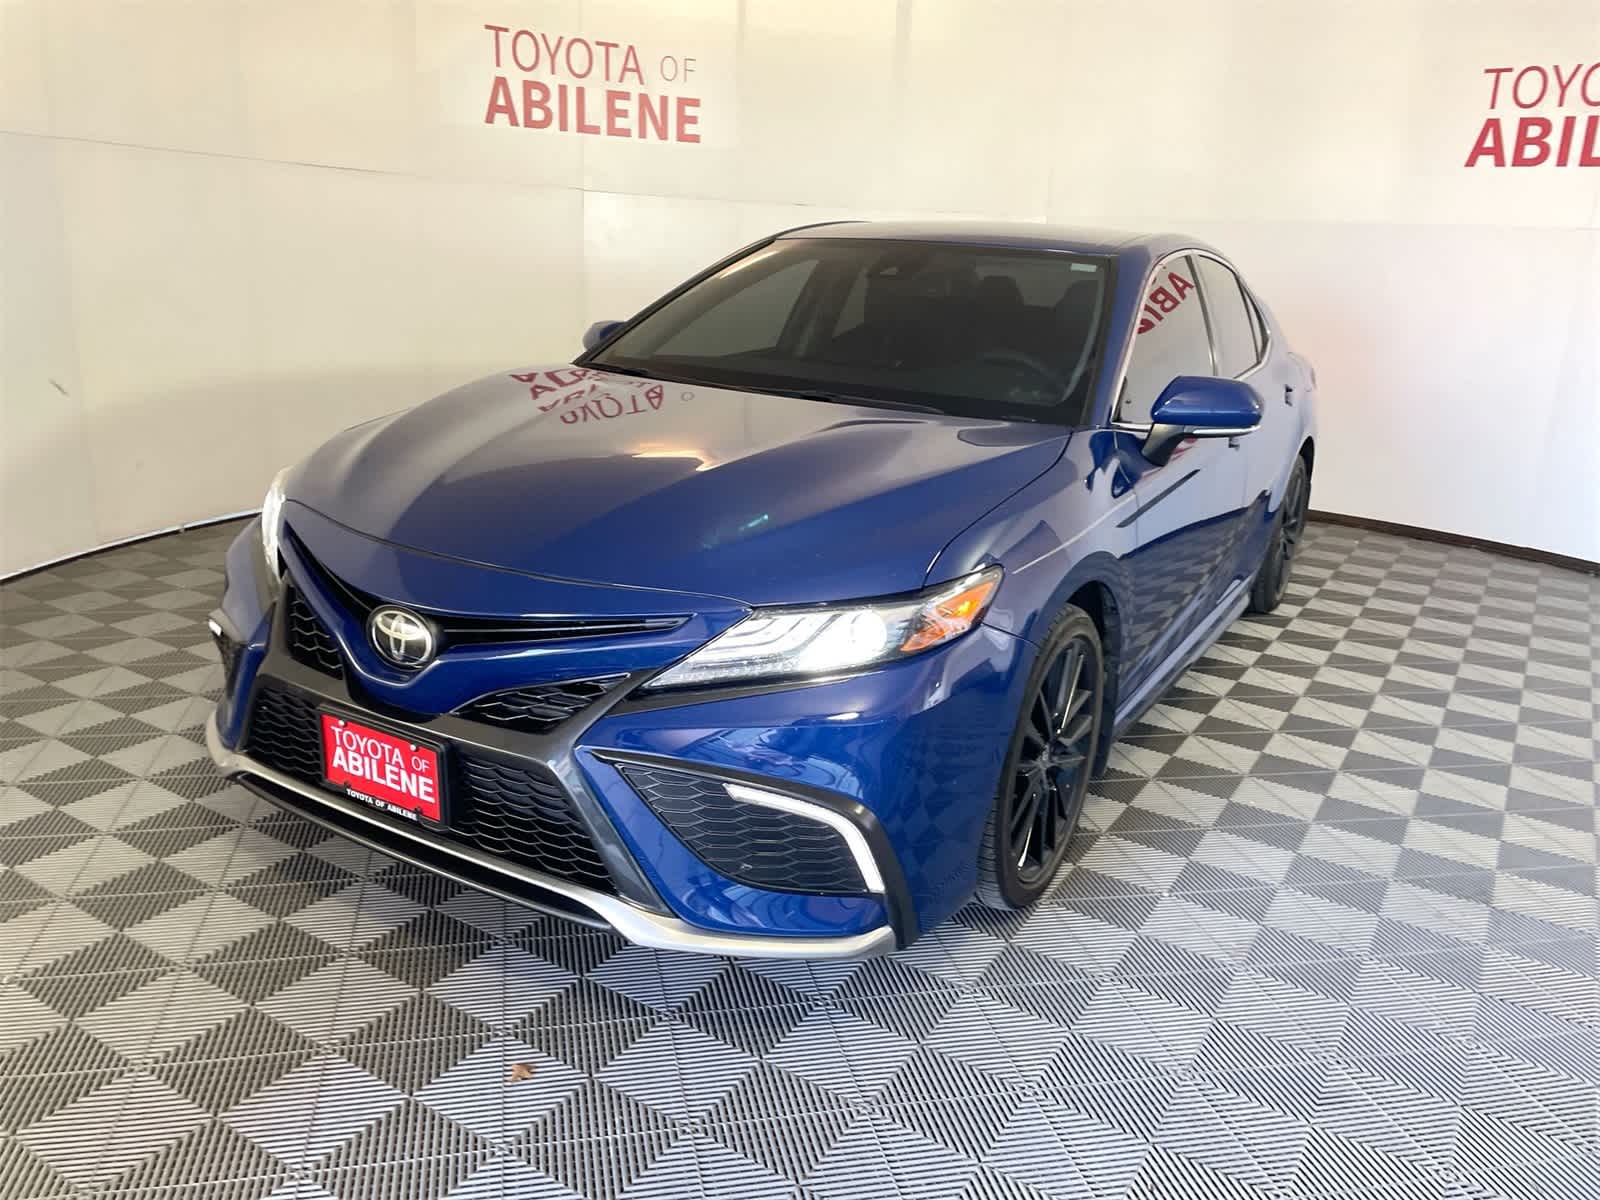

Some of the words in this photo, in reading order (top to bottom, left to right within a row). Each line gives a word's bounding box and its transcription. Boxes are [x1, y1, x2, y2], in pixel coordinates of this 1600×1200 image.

[484, 24, 645, 85] TOYOTA
[660, 55, 697, 83] OF
[484, 75, 701, 144] ABILENE
[331, 726, 405, 768] TOYOTA
[411, 756, 430, 772] OF
[332, 747, 435, 803] ABILENE
[346, 789, 373, 804] TOYOTA
[375, 799, 386, 808] OF
